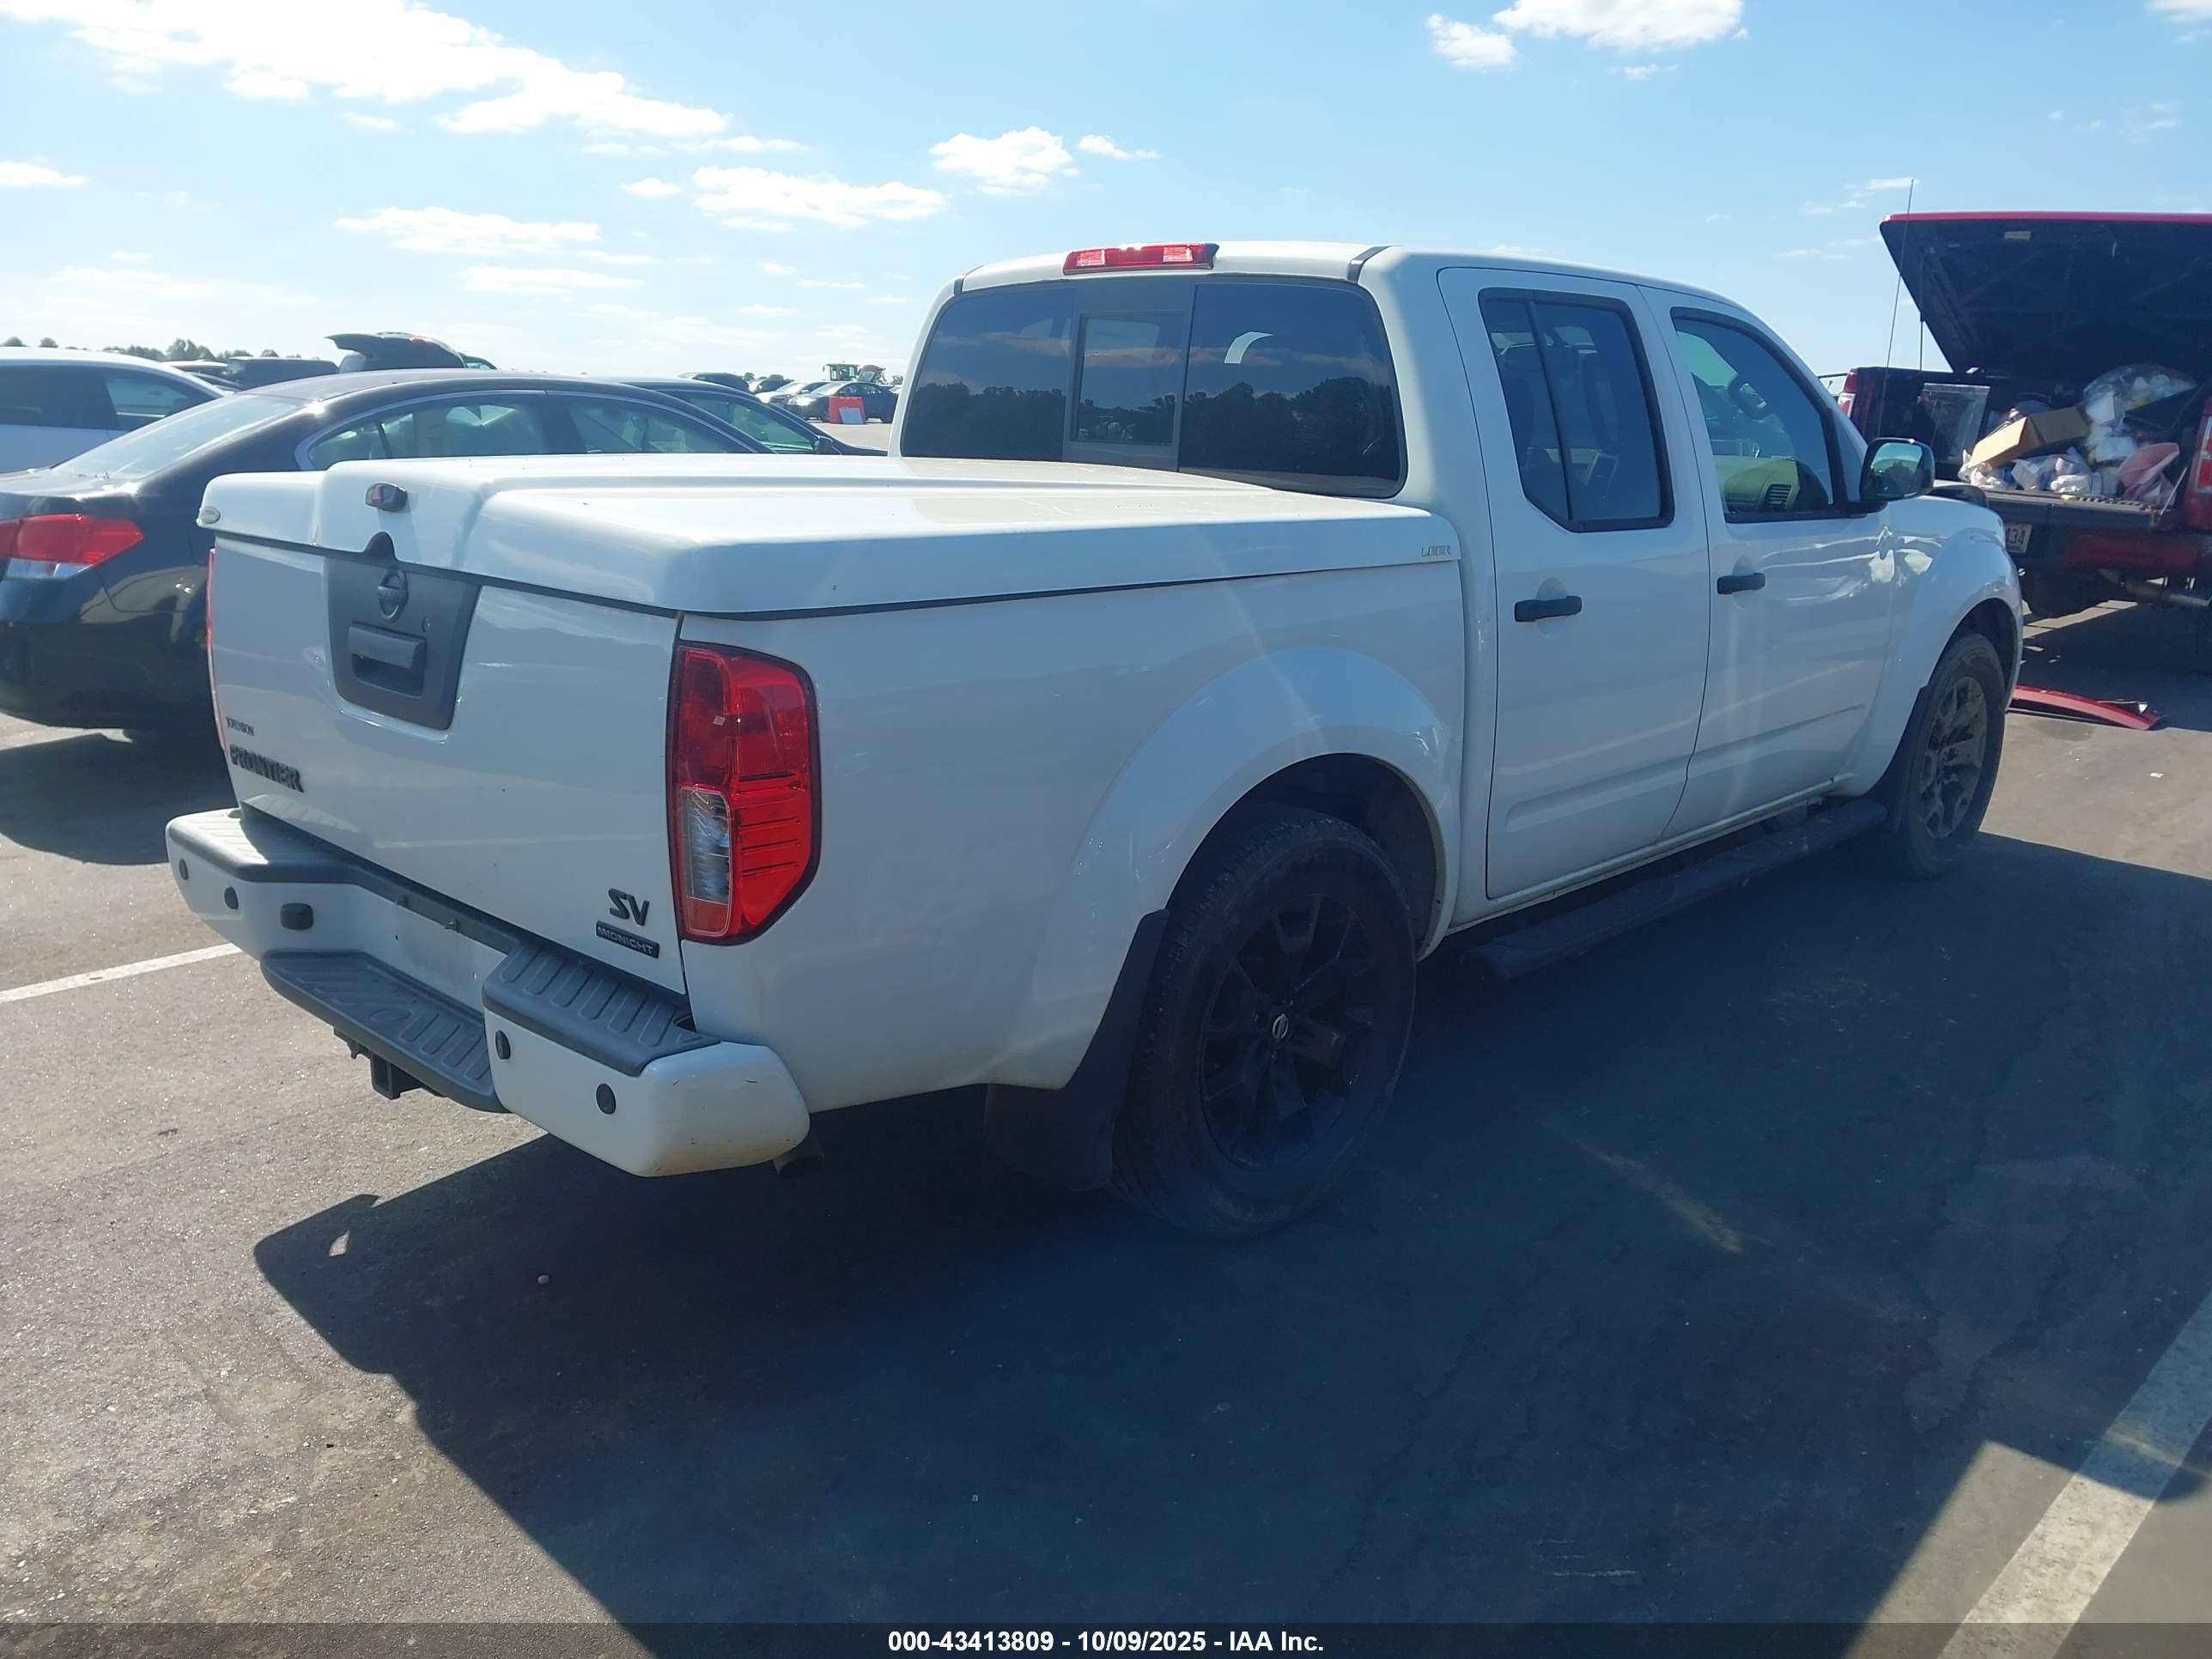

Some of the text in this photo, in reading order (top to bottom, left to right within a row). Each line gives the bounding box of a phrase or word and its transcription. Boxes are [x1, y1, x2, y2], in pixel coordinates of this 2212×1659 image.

[229, 743, 305, 793] FRONTIER
[608, 888, 650, 927] SV
[597, 926, 654, 955] MIDNIGHT
